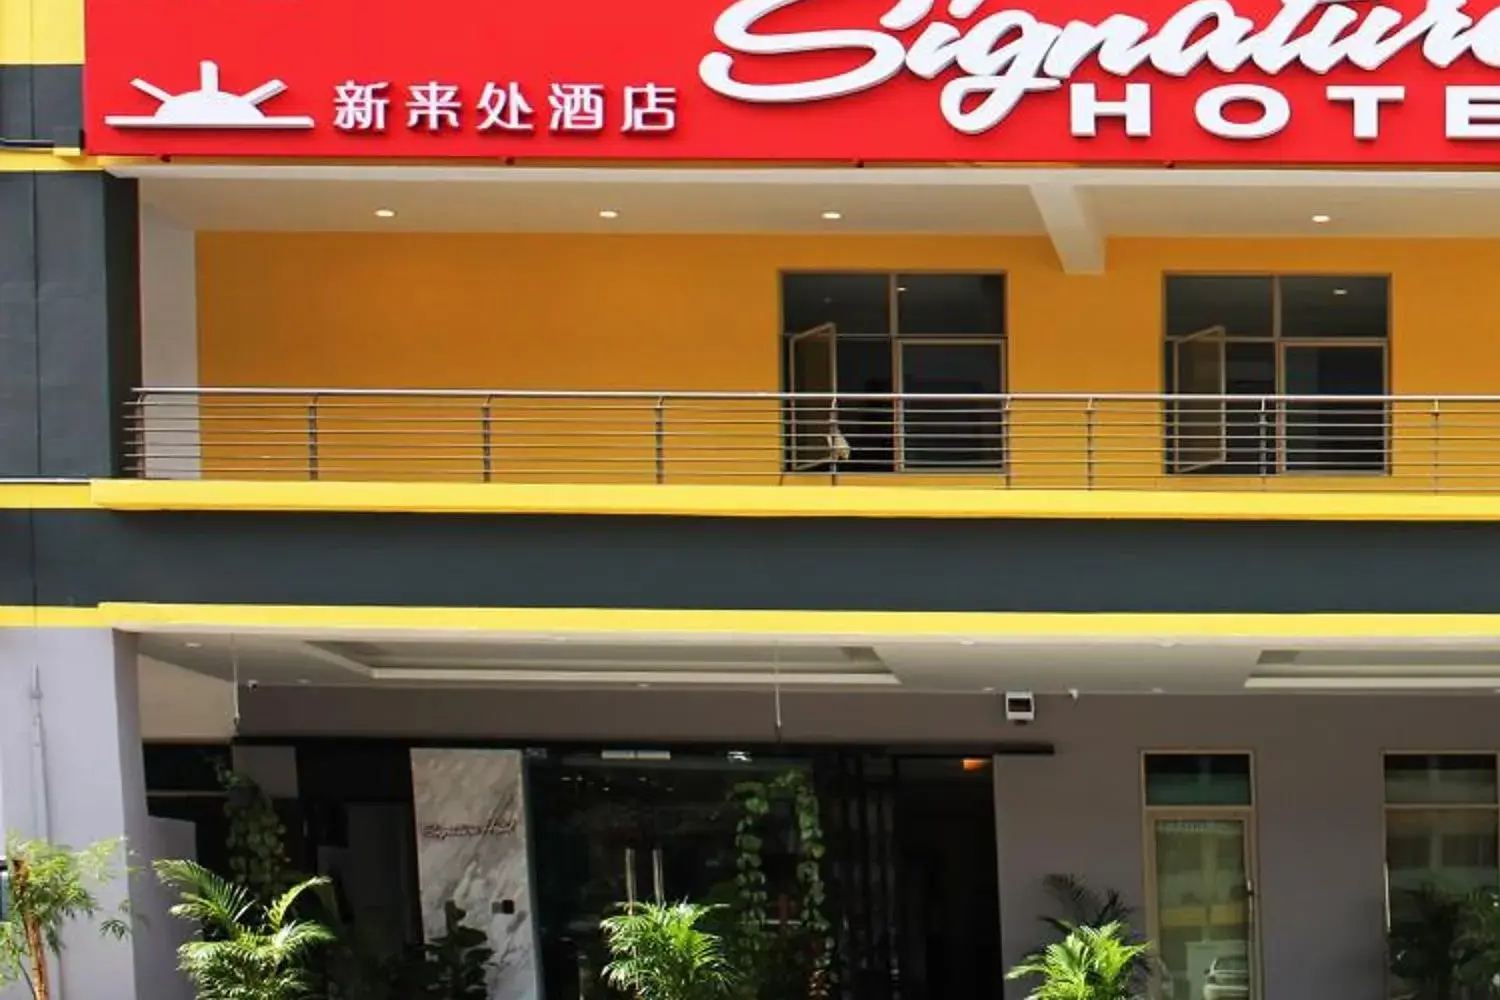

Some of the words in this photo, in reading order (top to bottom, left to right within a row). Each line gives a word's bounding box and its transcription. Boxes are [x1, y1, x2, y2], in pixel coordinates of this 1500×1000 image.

[333, 80, 676, 132] 新来处酒店
